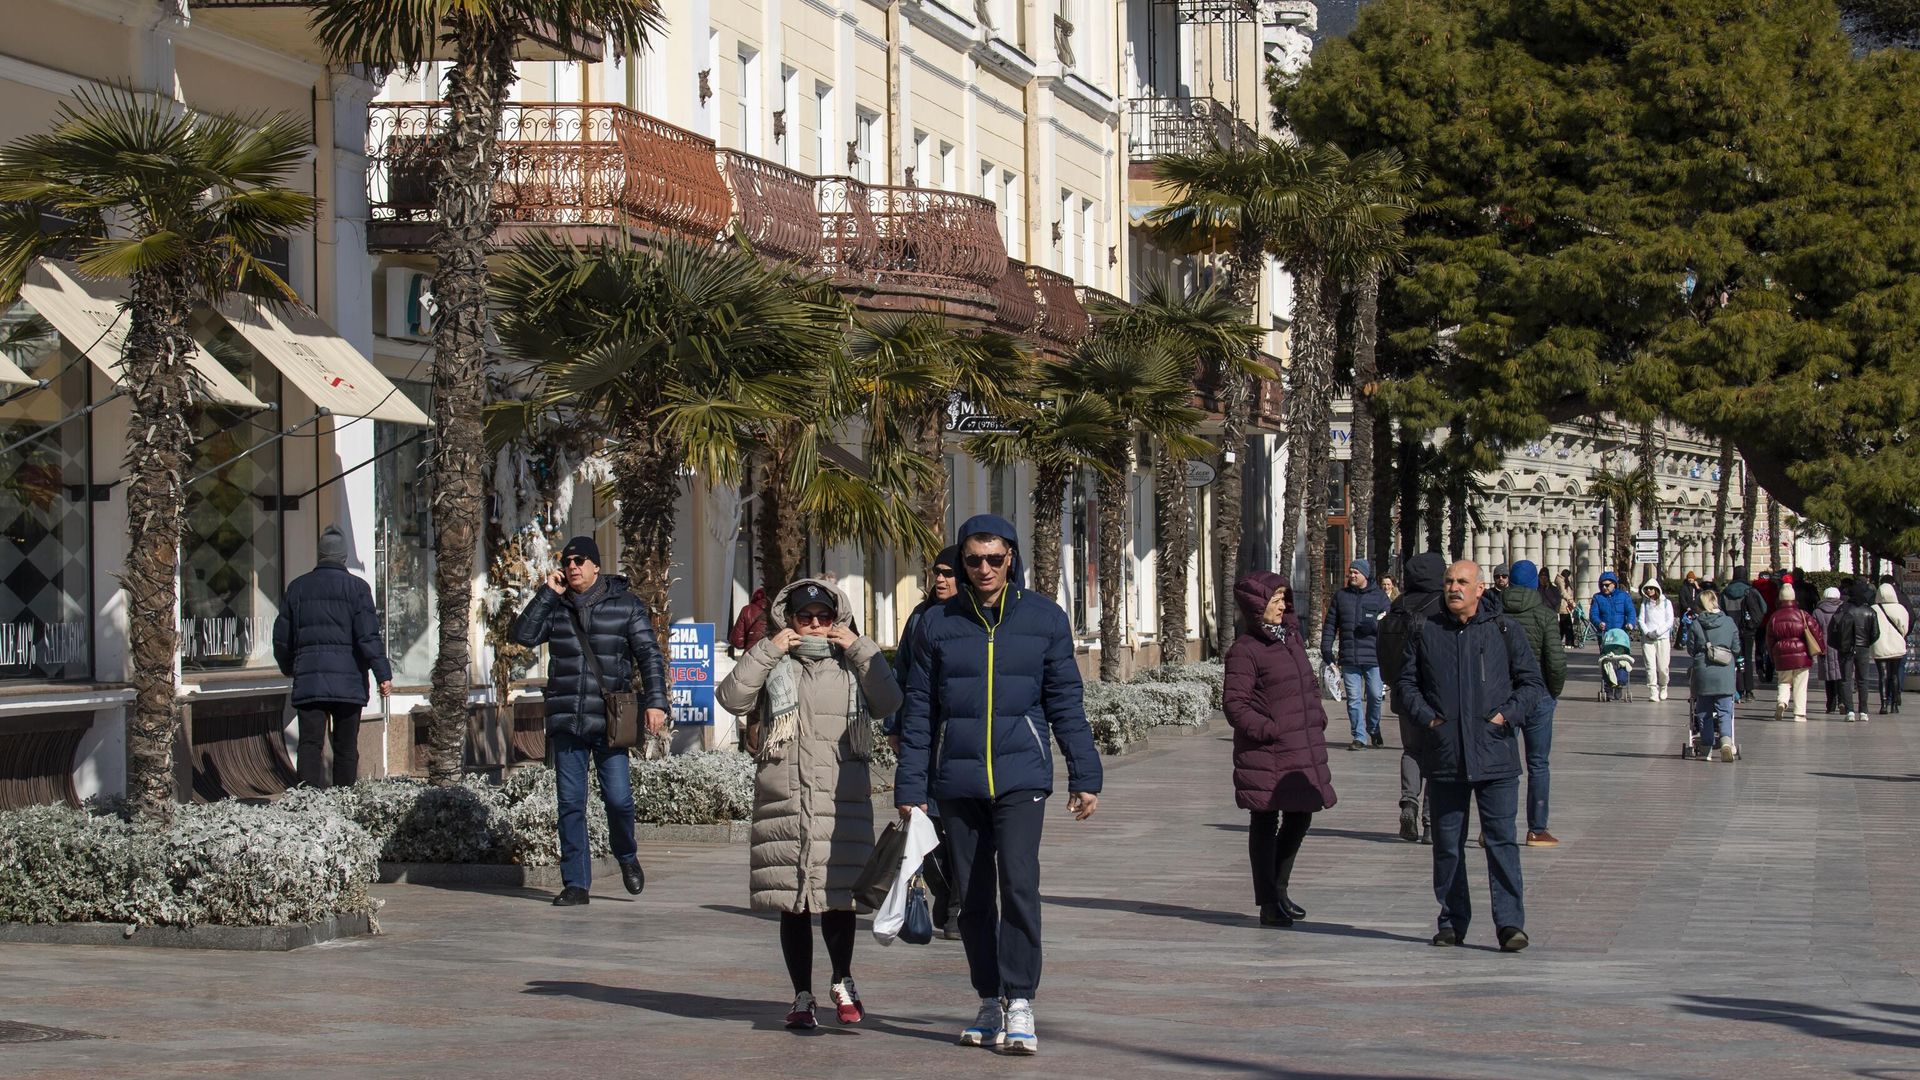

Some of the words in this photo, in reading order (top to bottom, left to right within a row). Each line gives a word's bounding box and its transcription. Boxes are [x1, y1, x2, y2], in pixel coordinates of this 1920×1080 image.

[203, 617, 222, 656] SALE
[223, 613, 239, 659] 40%
[669, 628, 698, 643] ВИА
[17, 617, 37, 670] 40%
[44, 622, 67, 664] SALE
[670, 644, 708, 659] ЛЕТЫ
[671, 707, 708, 721] ЛЕТЫ
